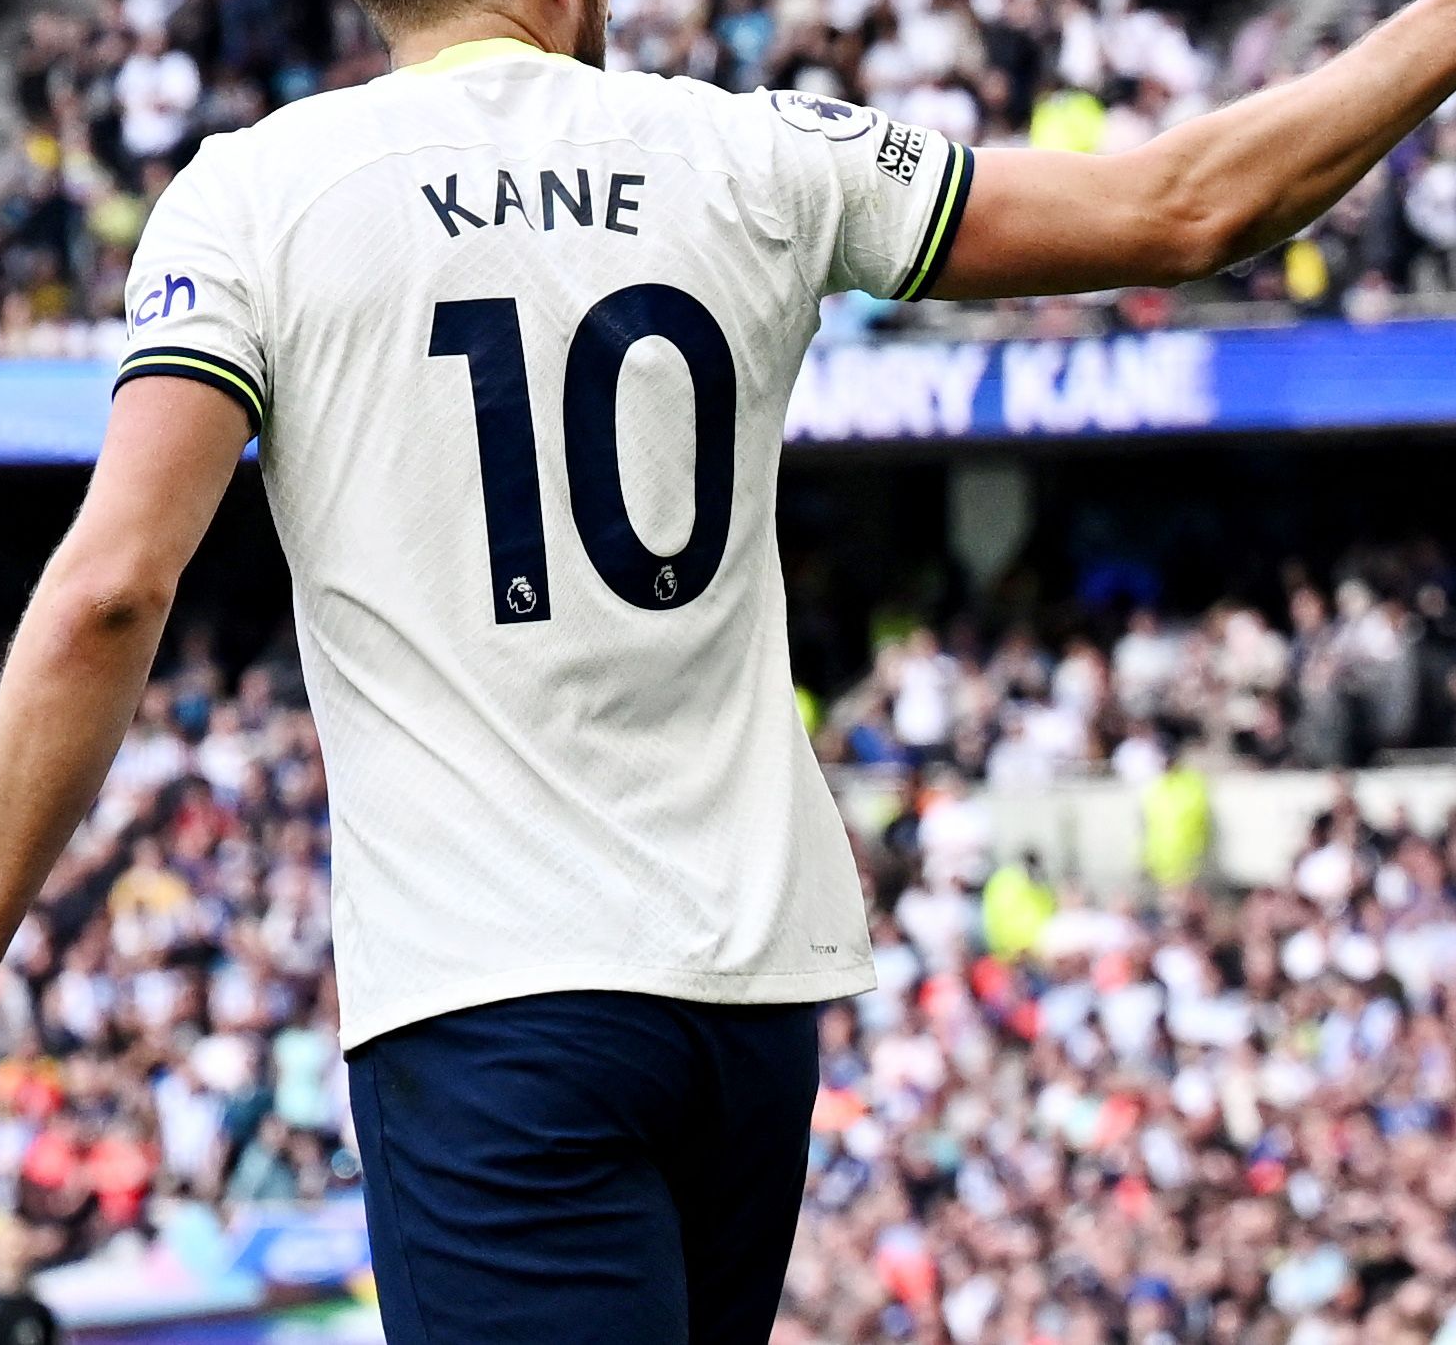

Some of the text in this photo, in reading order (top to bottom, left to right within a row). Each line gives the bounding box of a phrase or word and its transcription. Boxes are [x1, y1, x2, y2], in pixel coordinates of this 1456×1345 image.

[421, 168, 645, 238] KANE
[783, 332, 1222, 442] ARRY KANE
[428, 283, 737, 625] 10
